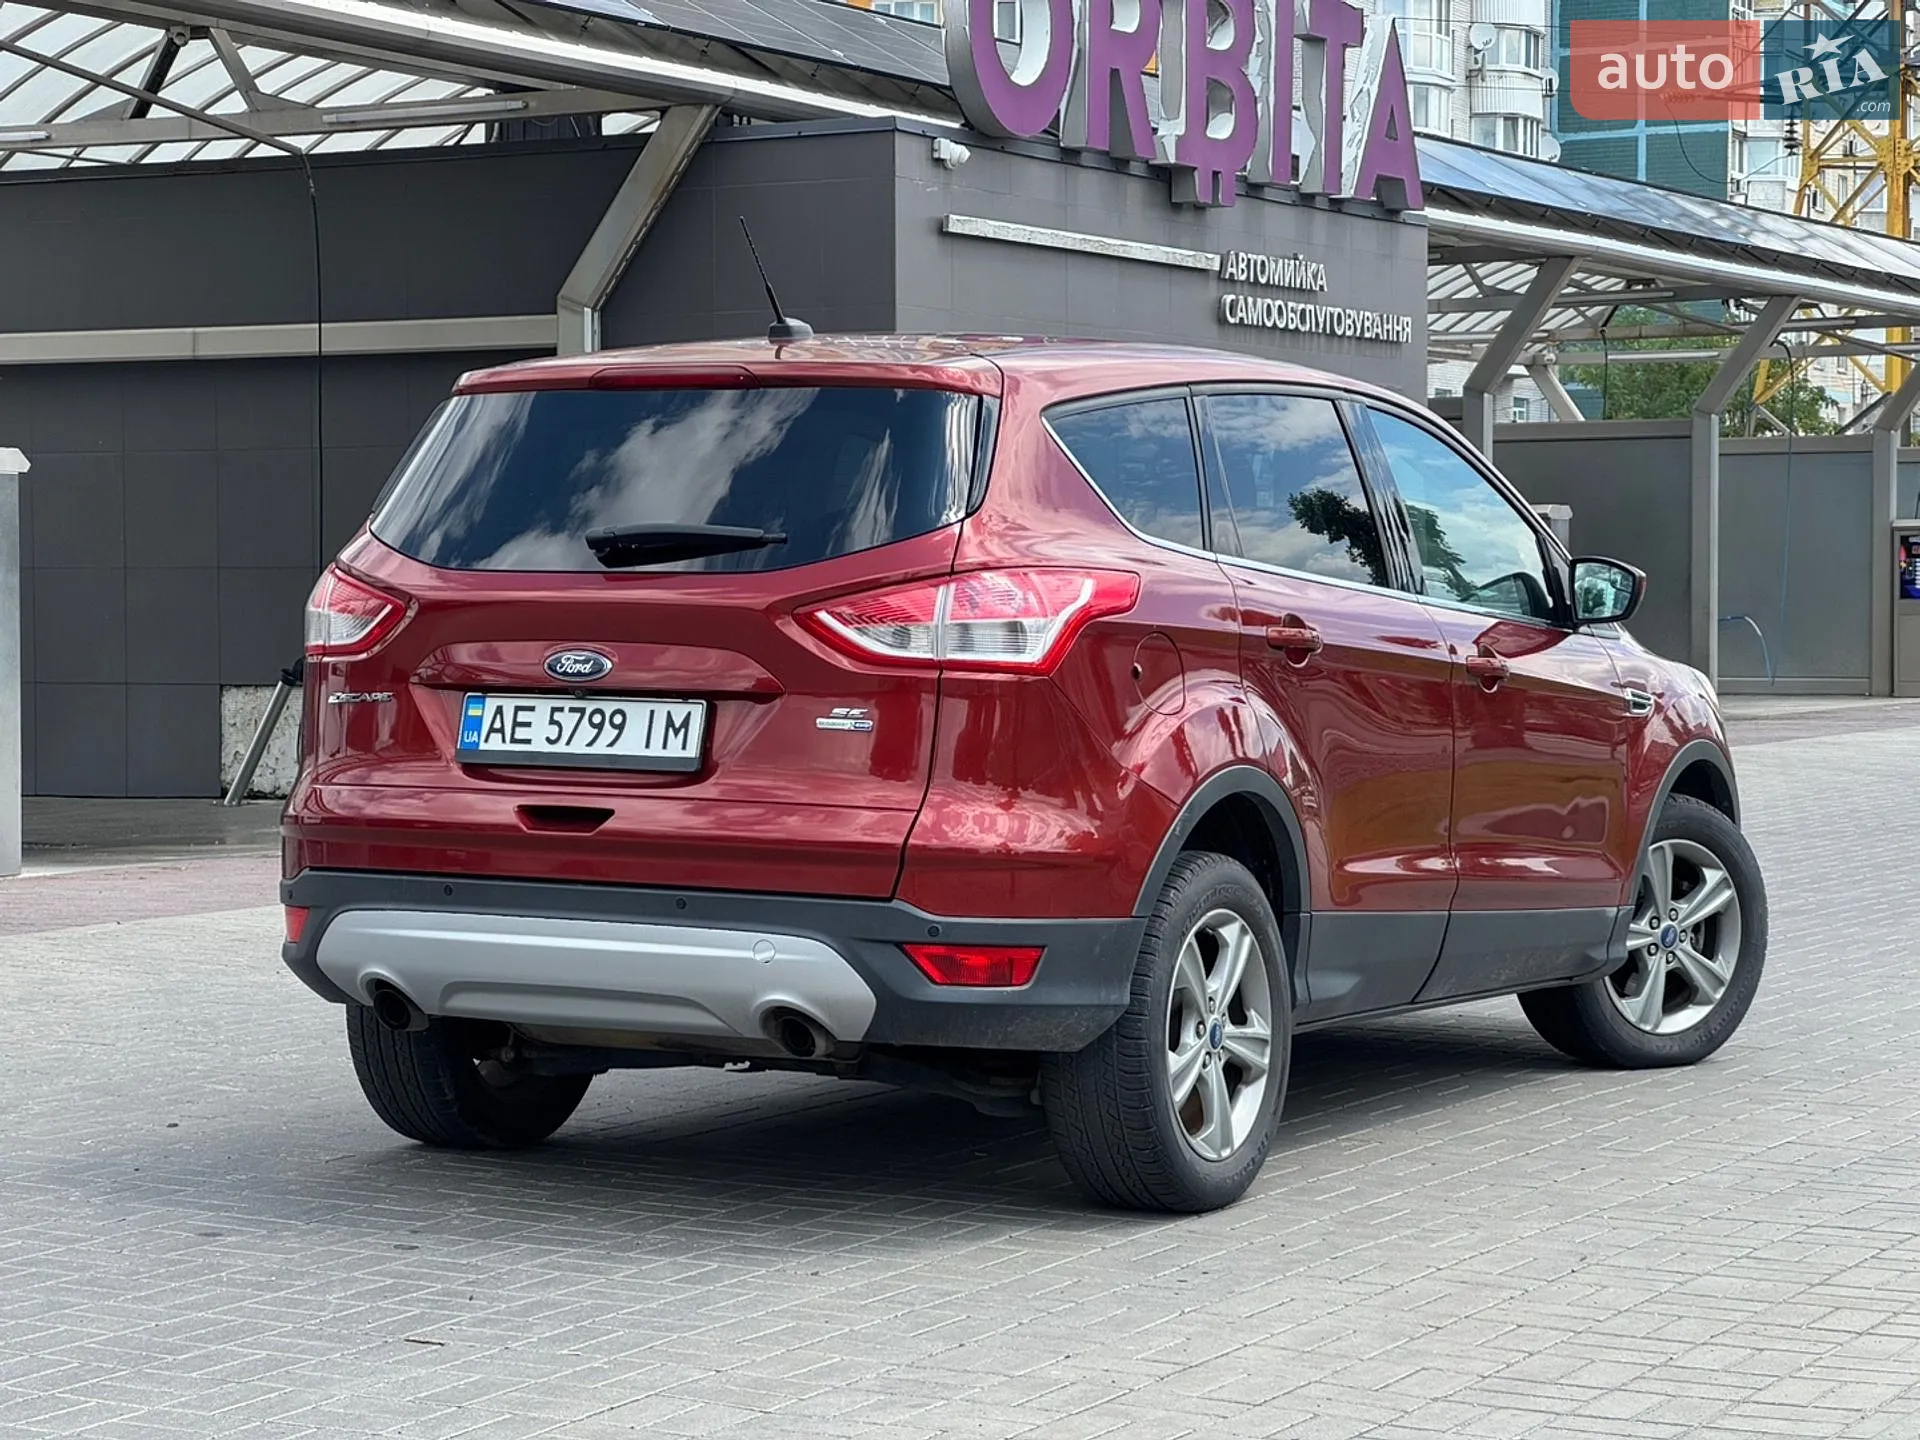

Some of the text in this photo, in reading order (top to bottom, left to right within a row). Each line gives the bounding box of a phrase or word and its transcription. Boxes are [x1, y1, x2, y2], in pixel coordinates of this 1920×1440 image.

[964, 0, 1424, 209] ORBITA
[1223, 251, 1328, 292] АВТОМИЙКА
[1223, 295, 1412, 343] САМООБСЛУГОВУВАННЯ
[556, 655, 596, 674] Ford
[464, 731, 479, 743] UA
[484, 705, 692, 751] AE 5799 IM
